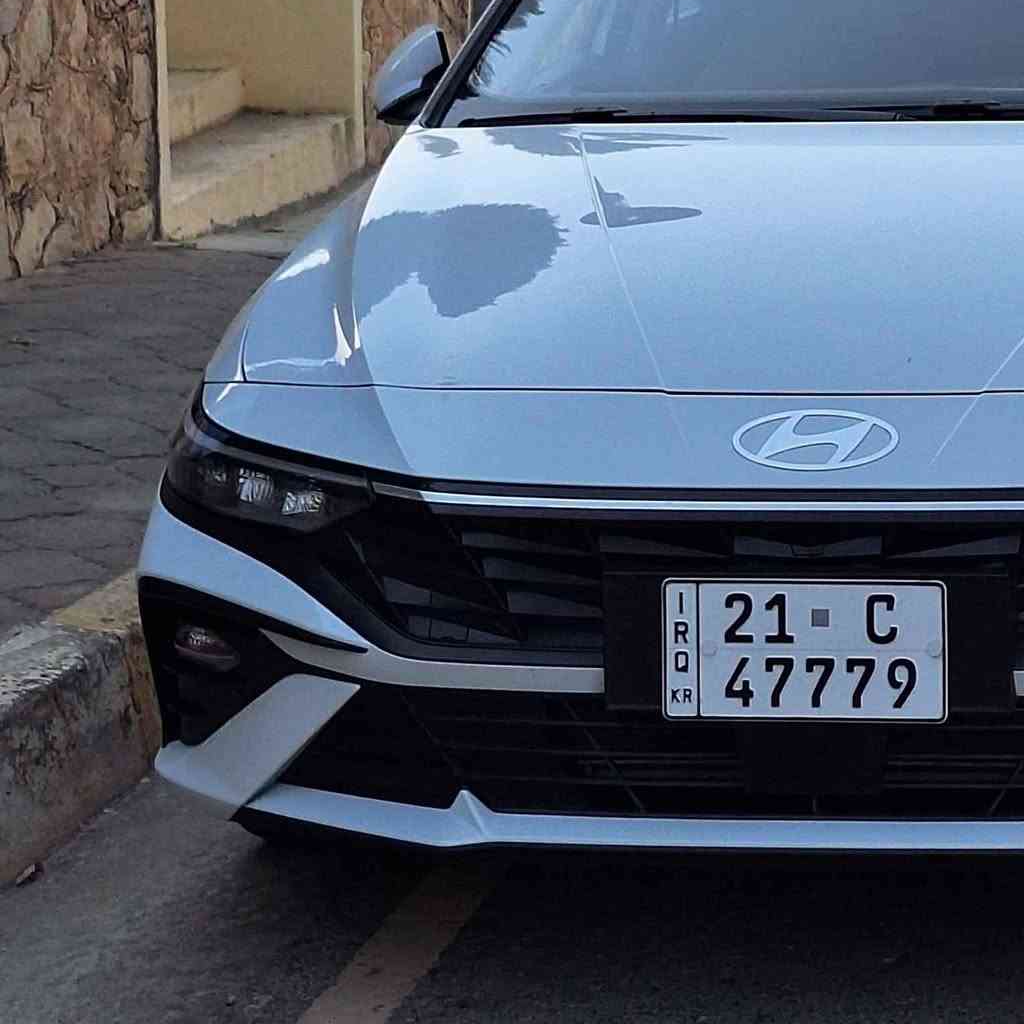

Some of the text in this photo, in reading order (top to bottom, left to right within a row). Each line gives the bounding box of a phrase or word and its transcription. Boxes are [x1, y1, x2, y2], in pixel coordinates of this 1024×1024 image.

[723, 591, 899, 645] 21 C
[670, 687, 693, 704] KR
[723, 656, 918, 709] 47779
